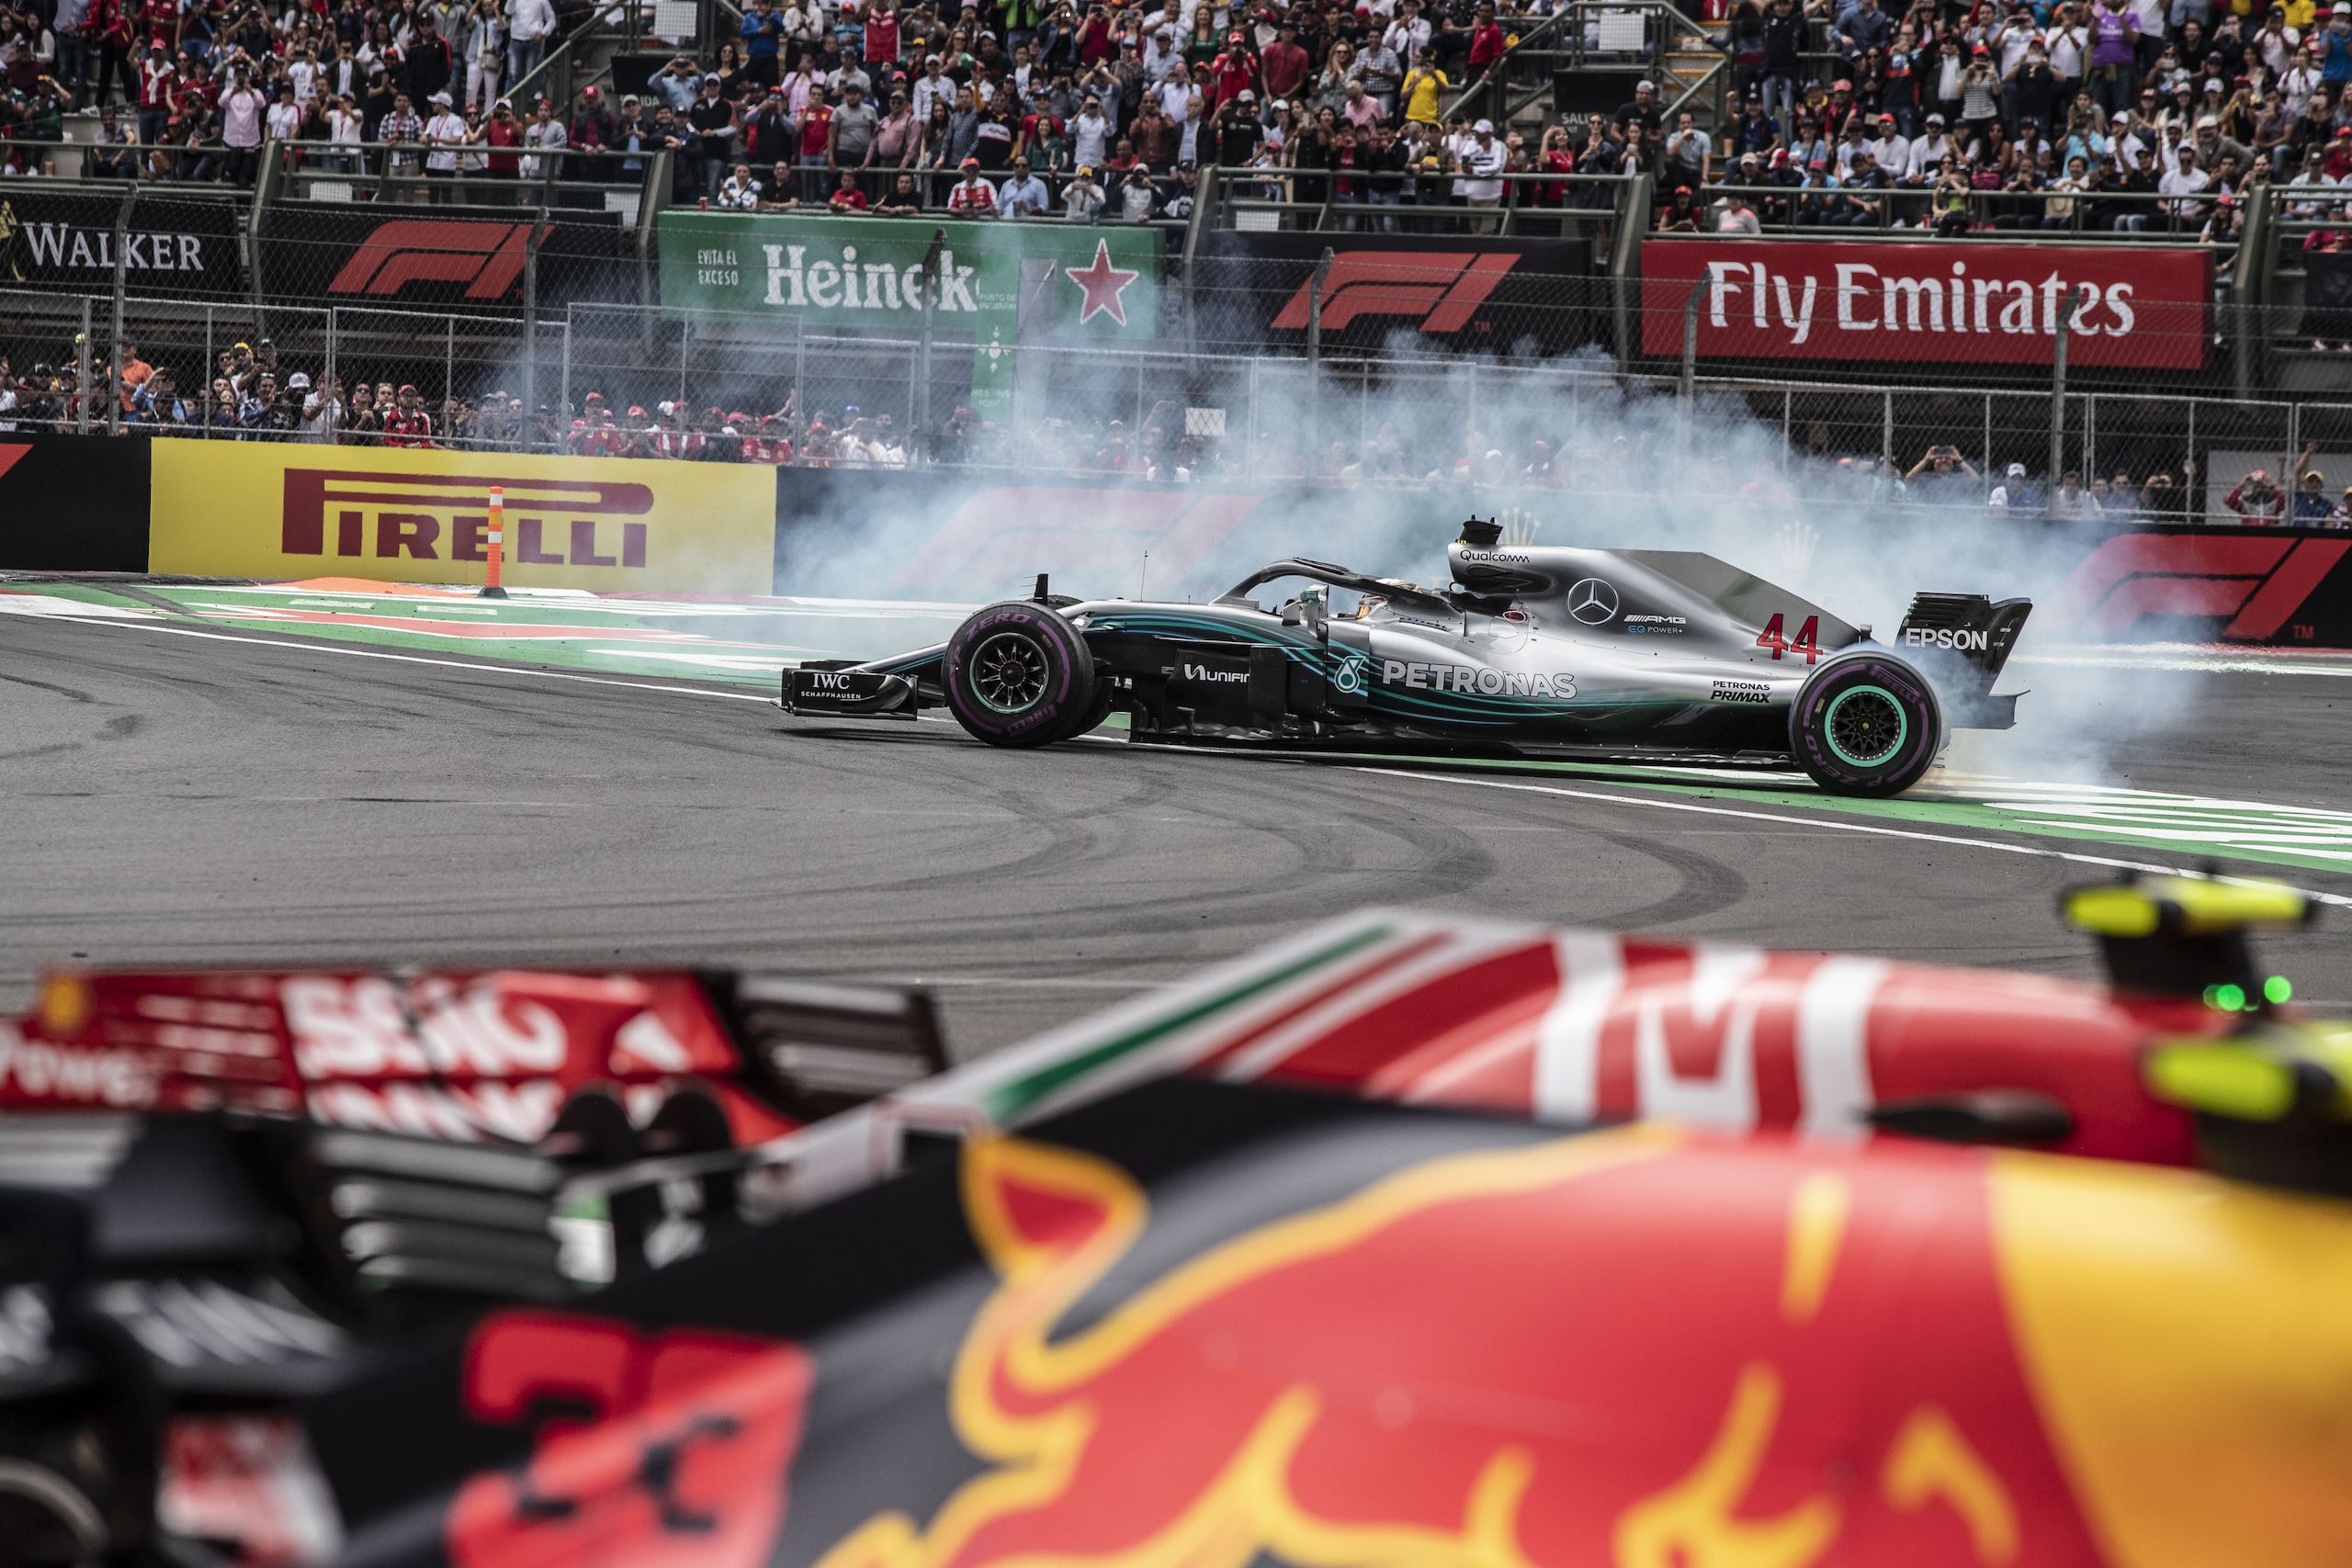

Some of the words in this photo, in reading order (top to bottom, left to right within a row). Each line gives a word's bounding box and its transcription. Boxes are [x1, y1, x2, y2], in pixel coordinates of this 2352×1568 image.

[1561, 112, 1608, 125] SALIA
[22, 221, 204, 271] WALKER
[697, 249, 724, 265] EVITA
[726, 251, 738, 265] EL
[697, 269, 739, 287] EXCESO
[762, 243, 980, 312] Heinek
[1708, 261, 1817, 344] Fly
[1835, 261, 2135, 337] Emirates
[281, 468, 654, 568] PIRELLI
[1460, 550, 1530, 563] Qualcomm
[966, 613, 1031, 642] ZERO
[1645, 615, 1686, 625] AMG
[1757, 613, 1823, 665] 44
[1905, 627, 1988, 650] EPSON
[812, 672, 850, 690] IWC
[1382, 660, 1577, 699] PETRONAS
[1713, 681, 1770, 691] PETRONAS
[800, 691, 862, 699] SCHAFFHAUSEN
[1710, 690, 1772, 704] PRIMAX
[1805, 735, 1859, 785] ZERO
